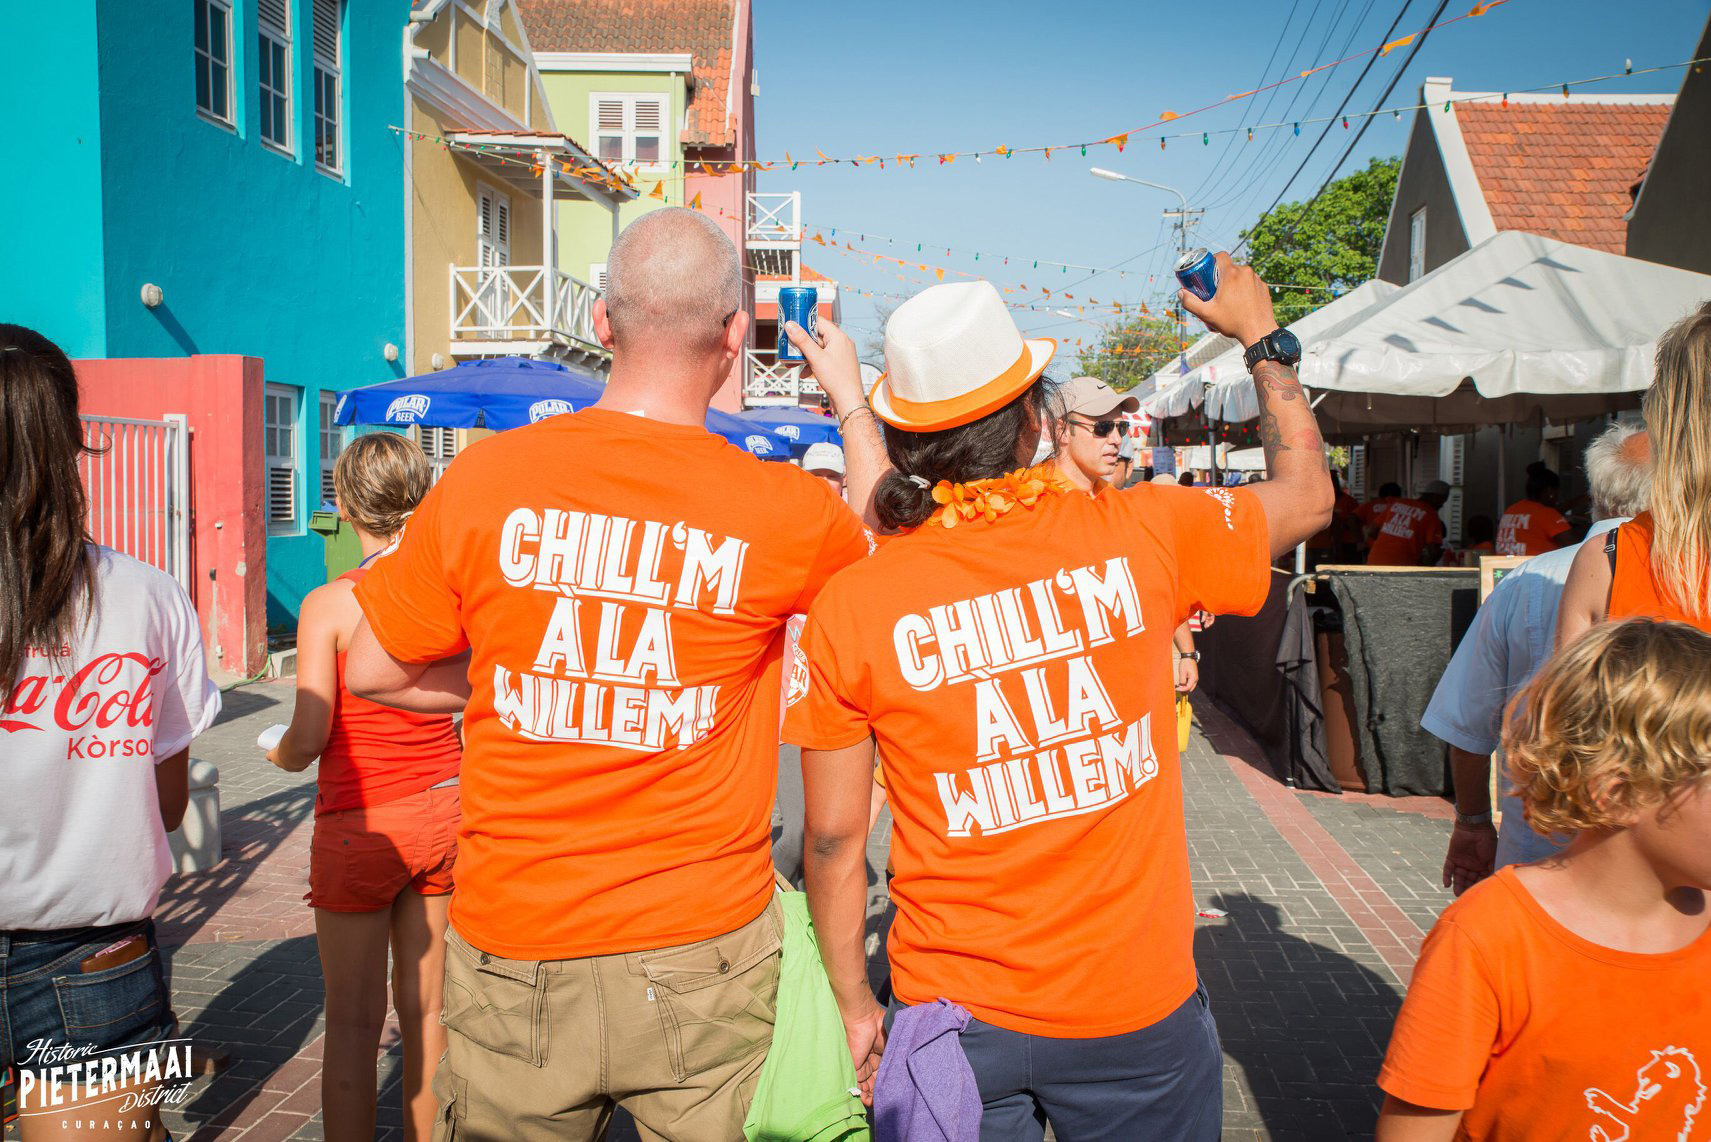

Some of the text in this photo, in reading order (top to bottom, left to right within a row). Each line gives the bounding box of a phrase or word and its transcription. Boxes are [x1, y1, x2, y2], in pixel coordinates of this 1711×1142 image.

[387, 396, 427, 419] POLAR
[395, 412, 415, 422] BEER
[499, 507, 750, 615] CHILL'M
[24, 640, 71, 658] frutá
[591, 601, 682, 686] LA
[893, 556, 1147, 692] CHILL'M
[2, 651, 168, 731] a-Col
[493, 663, 722, 753] WILLEM!
[1020, 655, 1123, 748] LA
[67, 734, 154, 760] Kòrso
[932, 711, 1160, 837] WILLEM!
